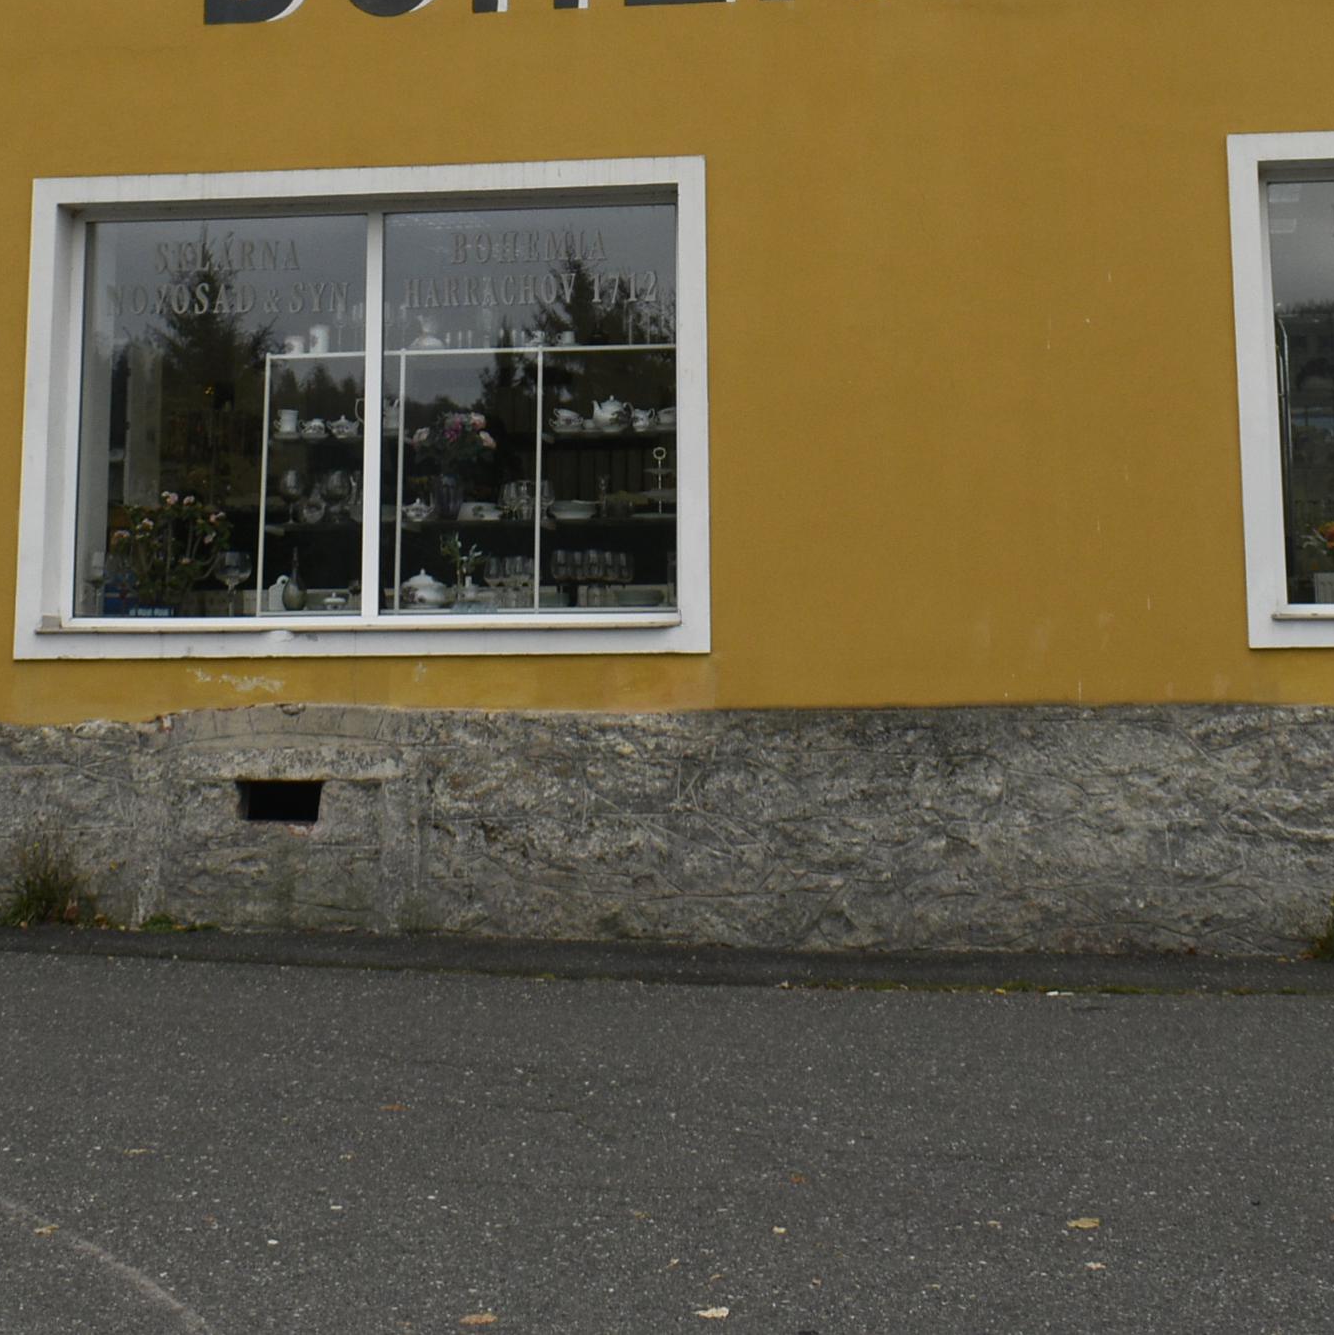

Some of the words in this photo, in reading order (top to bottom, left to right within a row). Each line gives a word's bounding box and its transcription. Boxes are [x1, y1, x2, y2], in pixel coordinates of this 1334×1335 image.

[155, 231, 301, 273] SKLÁRNA
[451, 227, 607, 265] BOHEMIA
[107, 281, 257, 316] NOVOSAD
[266, 288, 283, 314] &
[288, 280, 349, 314] SYN
[404, 272, 577, 309] HARRACHOV
[591, 270, 659, 305] 1712
